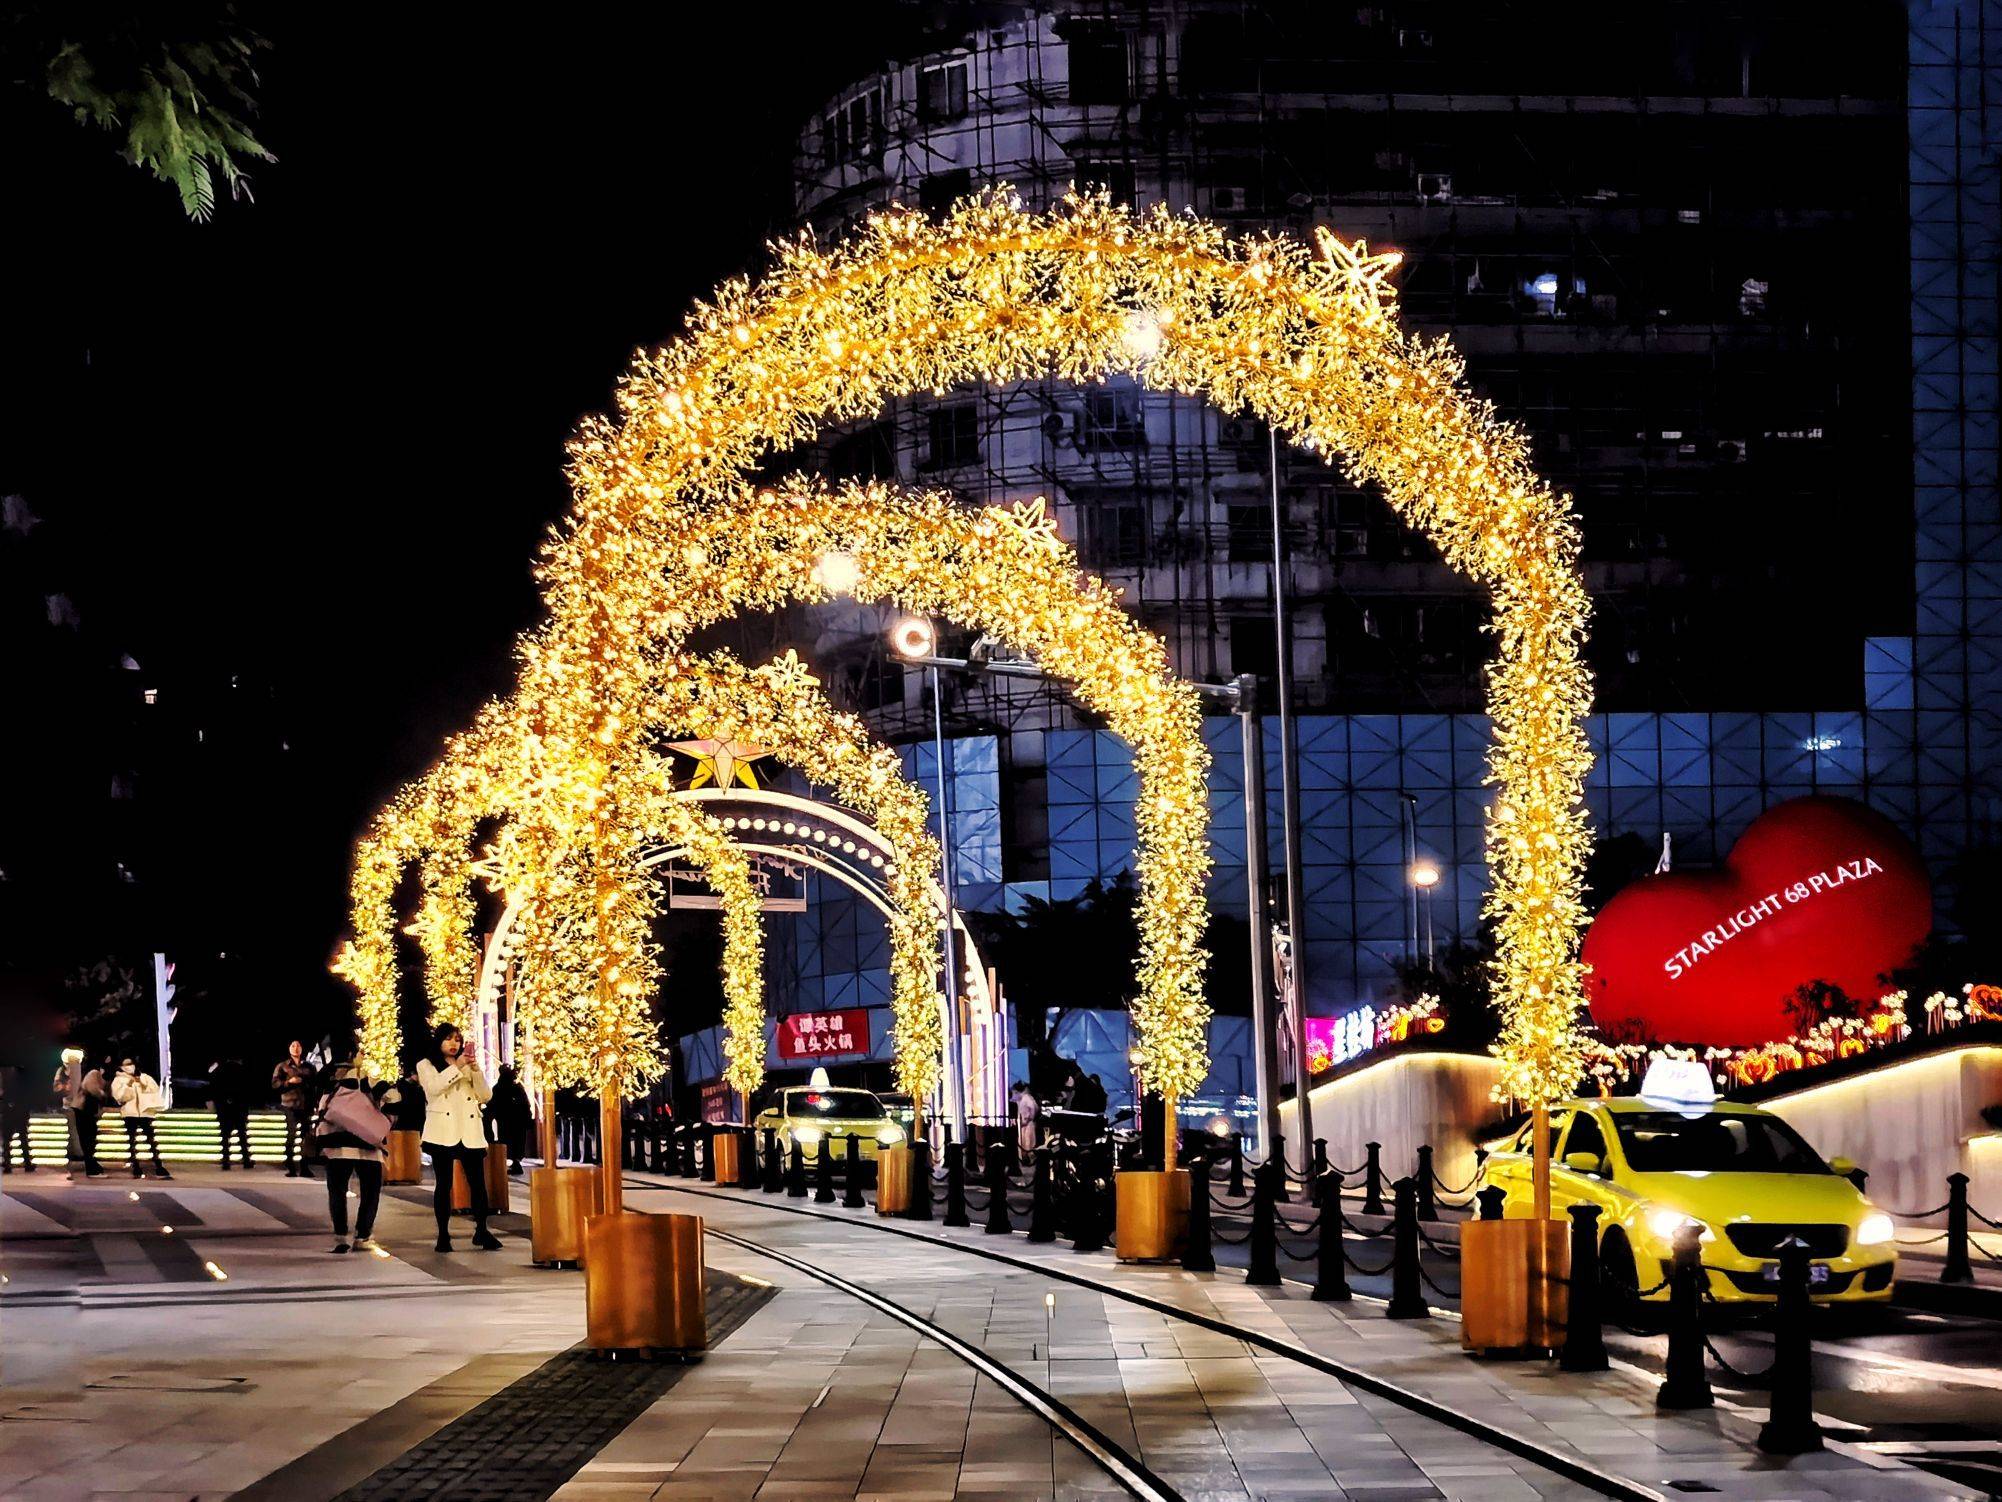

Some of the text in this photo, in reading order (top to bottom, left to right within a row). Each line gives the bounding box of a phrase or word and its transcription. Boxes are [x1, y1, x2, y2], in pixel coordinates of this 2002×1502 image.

[1664, 857, 1884, 980] STARLIGHT 68 PLAZA
[794, 1034, 854, 1053] 鱼头火锅
